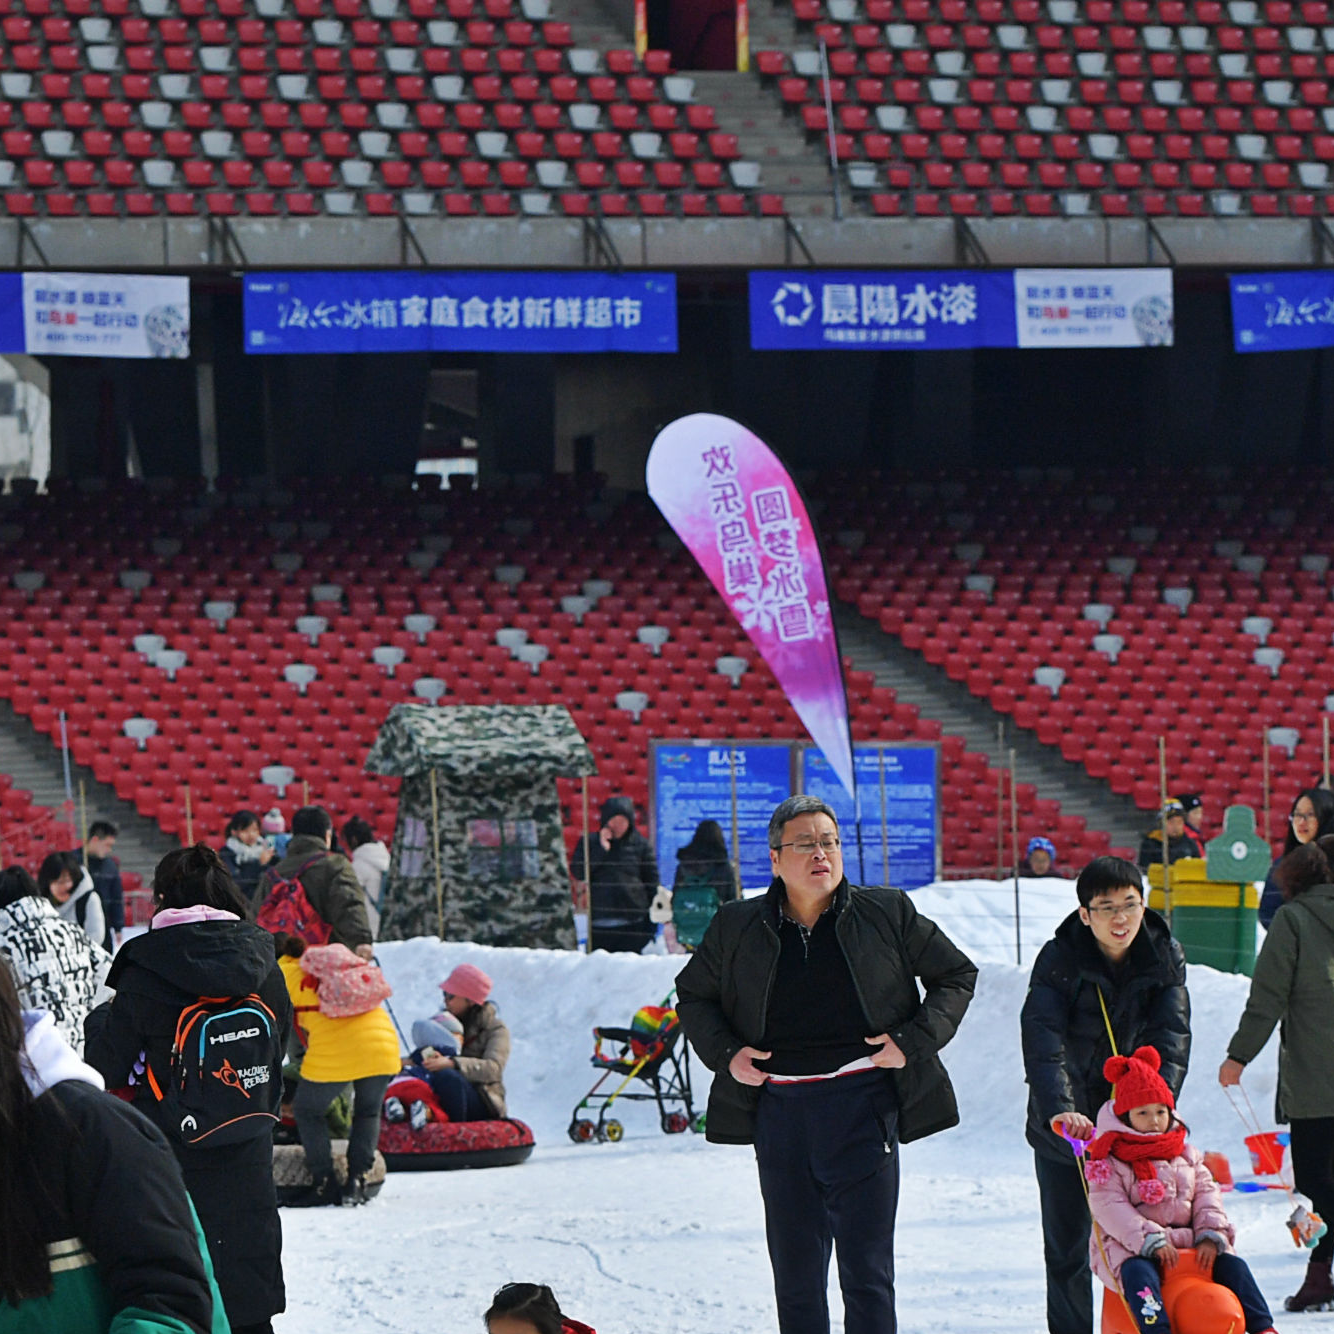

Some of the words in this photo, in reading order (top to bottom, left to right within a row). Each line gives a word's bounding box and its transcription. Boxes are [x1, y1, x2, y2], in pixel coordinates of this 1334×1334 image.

[821, 283, 977, 324] 晨陽水漆
[209, 1027, 261, 1045] HEAD
[237, 1065, 268, 1079] RACQUET
